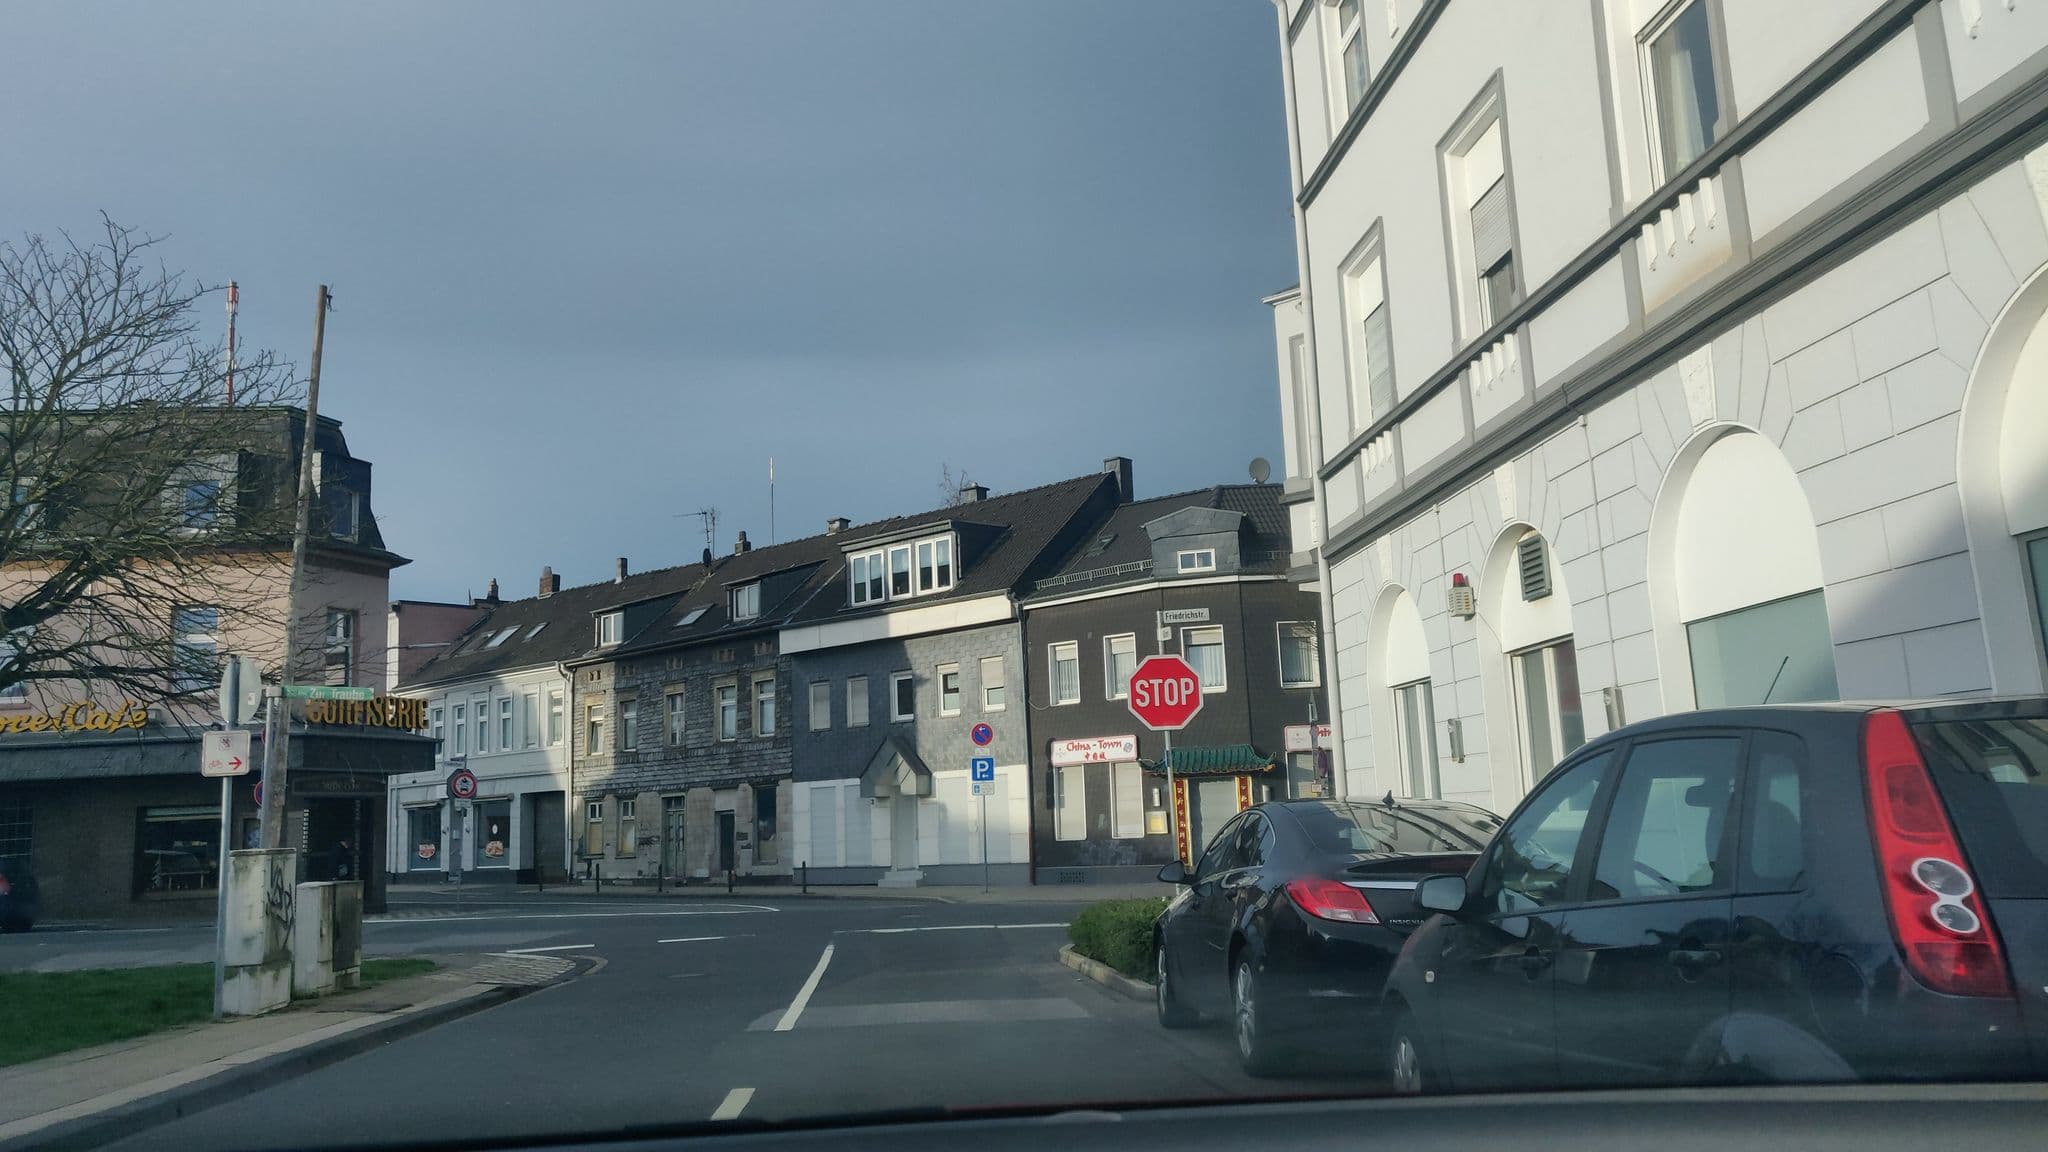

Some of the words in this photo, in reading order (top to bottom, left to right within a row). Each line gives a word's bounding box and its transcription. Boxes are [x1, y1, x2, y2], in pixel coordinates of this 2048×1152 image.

[1165, 610, 1207, 621] Friedrichstr.
[331, 687, 366, 701] Traube
[1135, 677, 1195, 708] STOP
[977, 760, 990, 779] P
